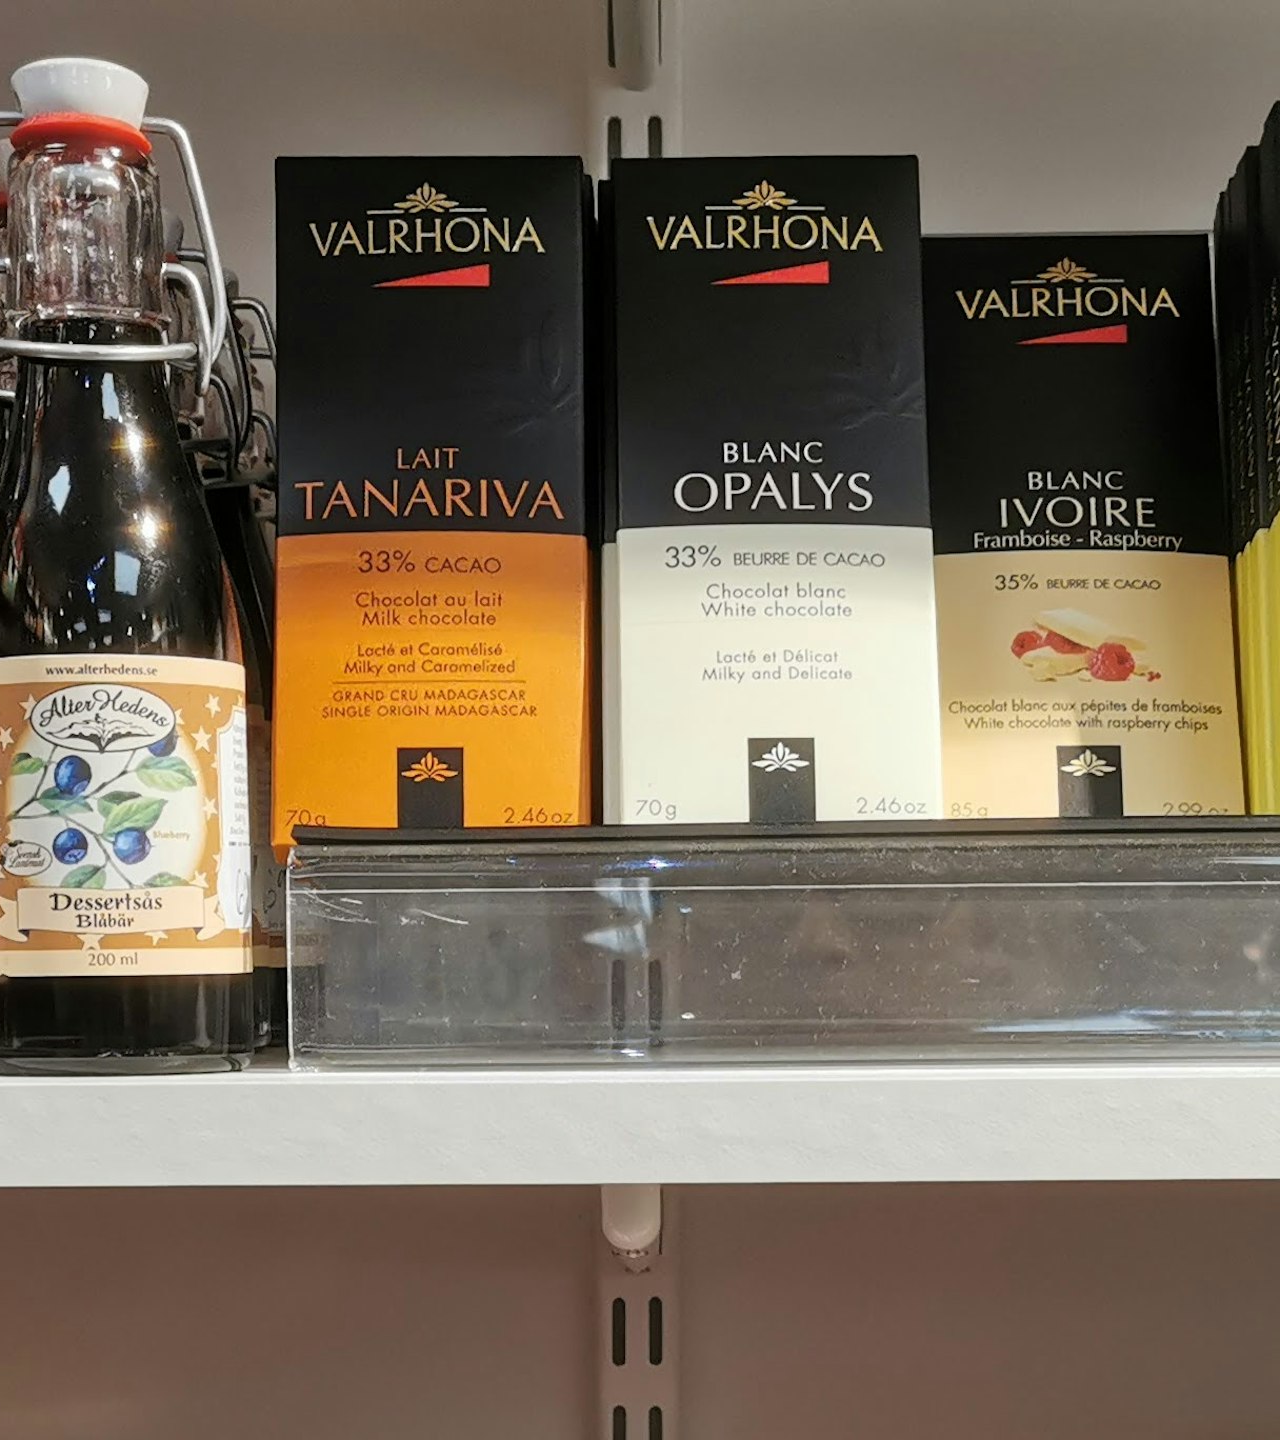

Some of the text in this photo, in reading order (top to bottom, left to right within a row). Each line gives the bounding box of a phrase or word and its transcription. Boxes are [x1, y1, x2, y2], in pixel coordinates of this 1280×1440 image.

[308, 214, 546, 257] VALRHONA
[645, 213, 884, 254] VALRHONA
[955, 286, 1181, 320] VALRHONA
[397, 448, 459, 469] LAIT
[723, 441, 823, 463] BLANC
[1028, 471, 1124, 490] BLANC
[294, 478, 564, 520] TANARIVA
[673, 472, 874, 512] OPALYS
[1000, 496, 1156, 528] IVOIRE
[973, 529, 1183, 550] Framboise Raspberry
[358, 550, 502, 574] 33% CACAO
[665, 545, 885, 568] 33% BEURRE DE CACAO
[706, 582, 846, 599] Chocolat blanc
[994, 574, 1161, 591] 35% BEURRE DE CACAO
[355, 590, 503, 608] Chocolat au lait
[361, 610, 496, 626] Milk chocolate
[701, 601, 852, 618] White chocolate
[45, 665, 158, 676] www.alterhedens.se
[343, 660, 380, 677] Milky
[387, 660, 416, 673] and
[39, 689, 170, 727] Alter Hedens
[322, 705, 537, 718] SINGLE ORIGIN MADAGASCAR
[49, 893, 163, 912] Dessertsås
[76, 913, 135, 928] Blåbär
[87, 953, 138, 967] 200 ml
